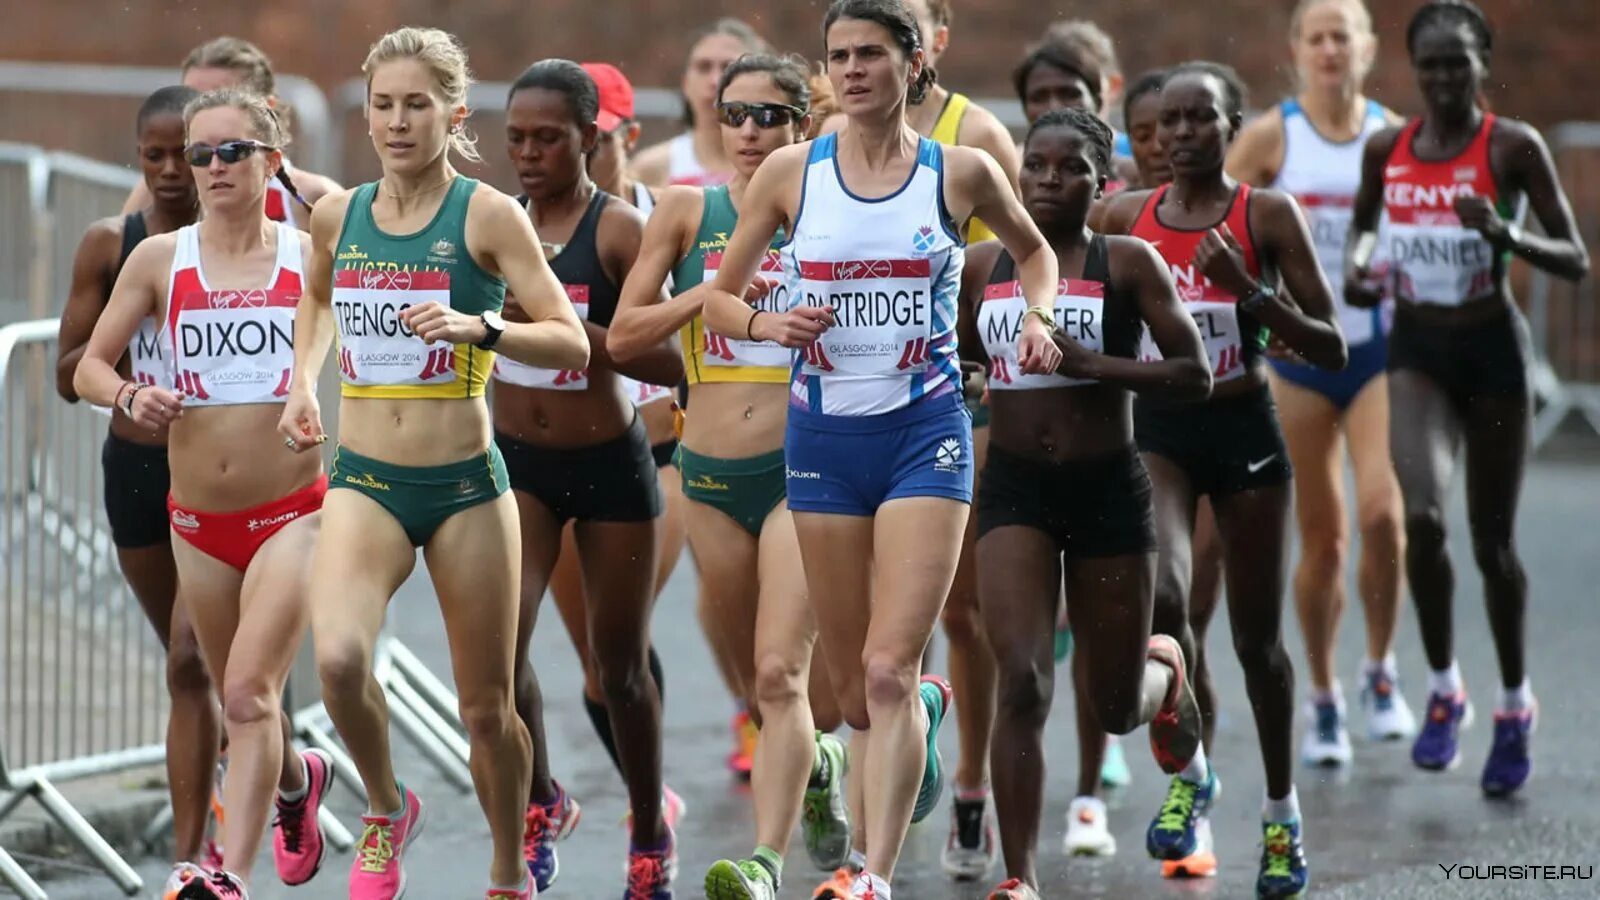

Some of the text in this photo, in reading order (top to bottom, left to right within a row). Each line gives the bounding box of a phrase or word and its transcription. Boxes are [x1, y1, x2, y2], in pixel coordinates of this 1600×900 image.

[181, 320, 294, 358] DIXON
[829, 343, 899, 354] GLASGOW 2014
[402, 353, 420, 362] 2014
[790, 470, 820, 479] KUKRI
[346, 475, 390, 491] DIADORA
[259, 511, 298, 527] KUKRI
